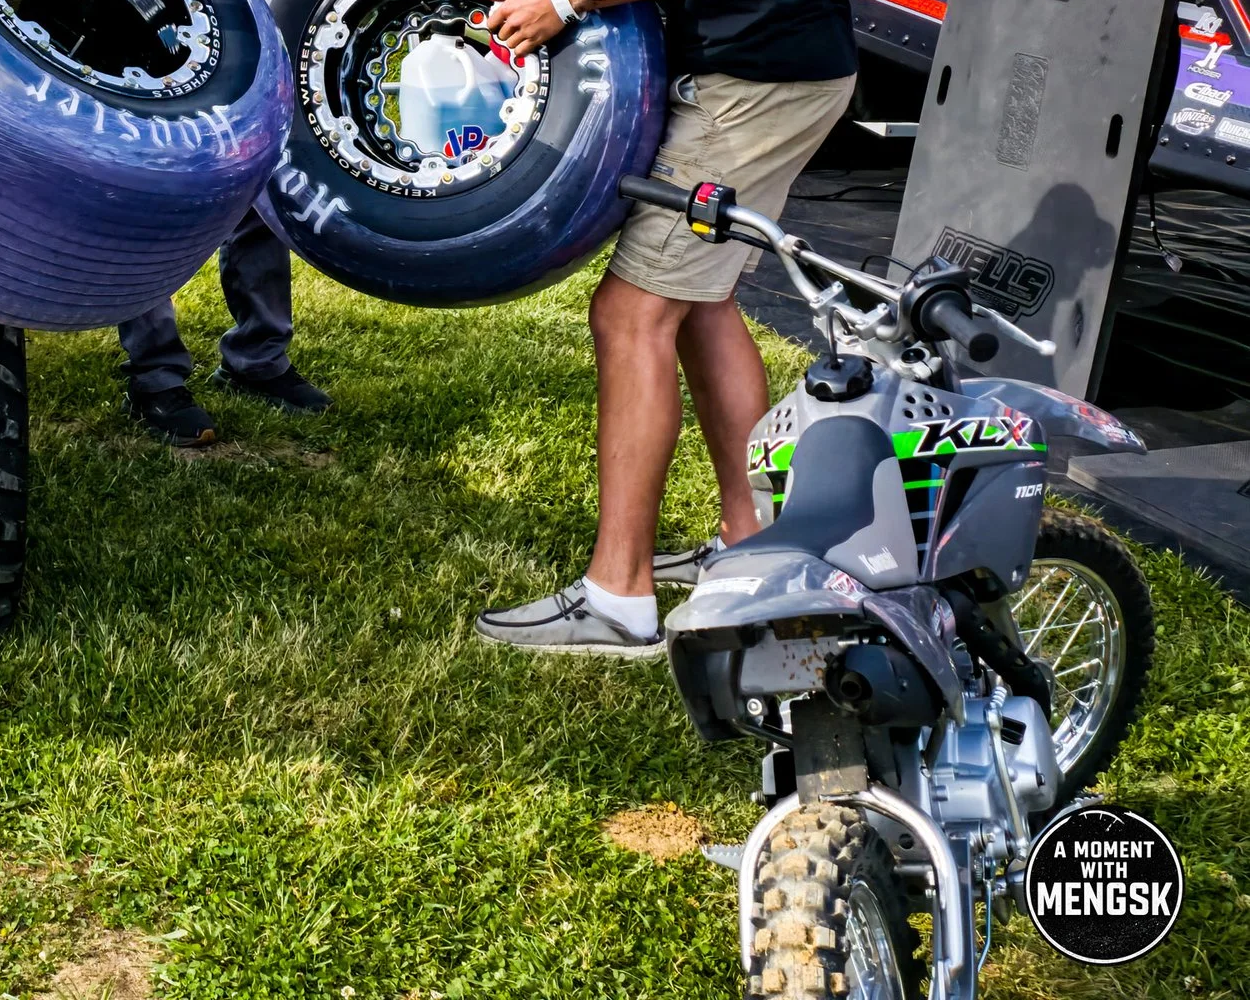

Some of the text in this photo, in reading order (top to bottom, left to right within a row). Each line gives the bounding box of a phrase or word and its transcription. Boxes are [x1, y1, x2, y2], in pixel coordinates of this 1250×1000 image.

[205, 4, 220, 67] FORGED
[300, 24, 317, 105] WHEELS
[1187, 66, 1222, 79] HOOSIER
[152, 69, 211, 98] WHEELS
[1171, 110, 1215, 126] WINTERS
[307, 112, 361, 178] FORGED
[366, 177, 437, 197] KEIZER
[910, 416, 1033, 457] KLX
